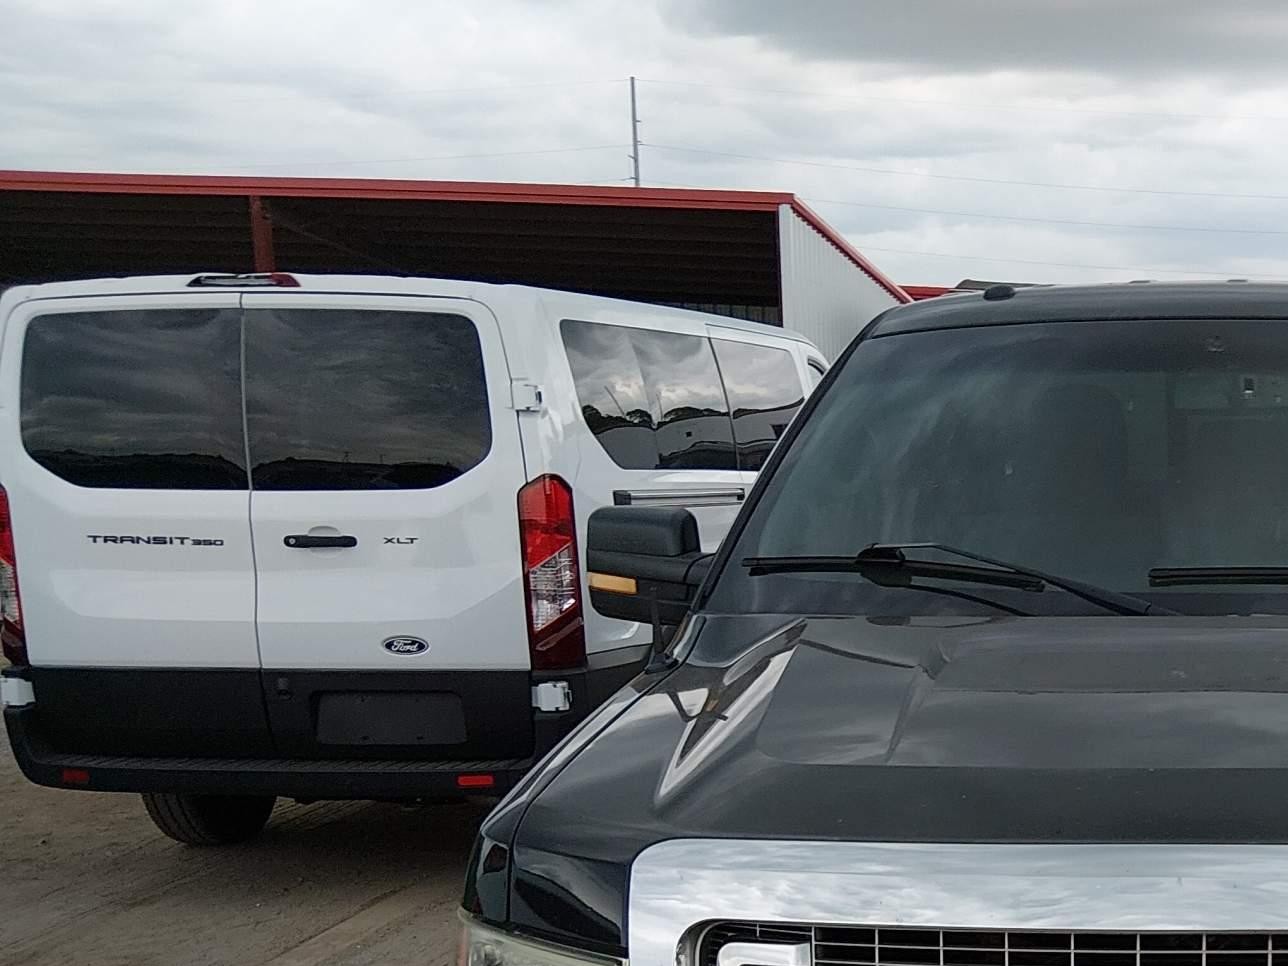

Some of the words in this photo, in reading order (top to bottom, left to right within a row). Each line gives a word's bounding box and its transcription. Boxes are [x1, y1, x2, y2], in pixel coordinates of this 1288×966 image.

[87, 535, 190, 545] TRANSIT
[383, 537, 419, 545] XLT
[391, 640, 419, 652] Ford
